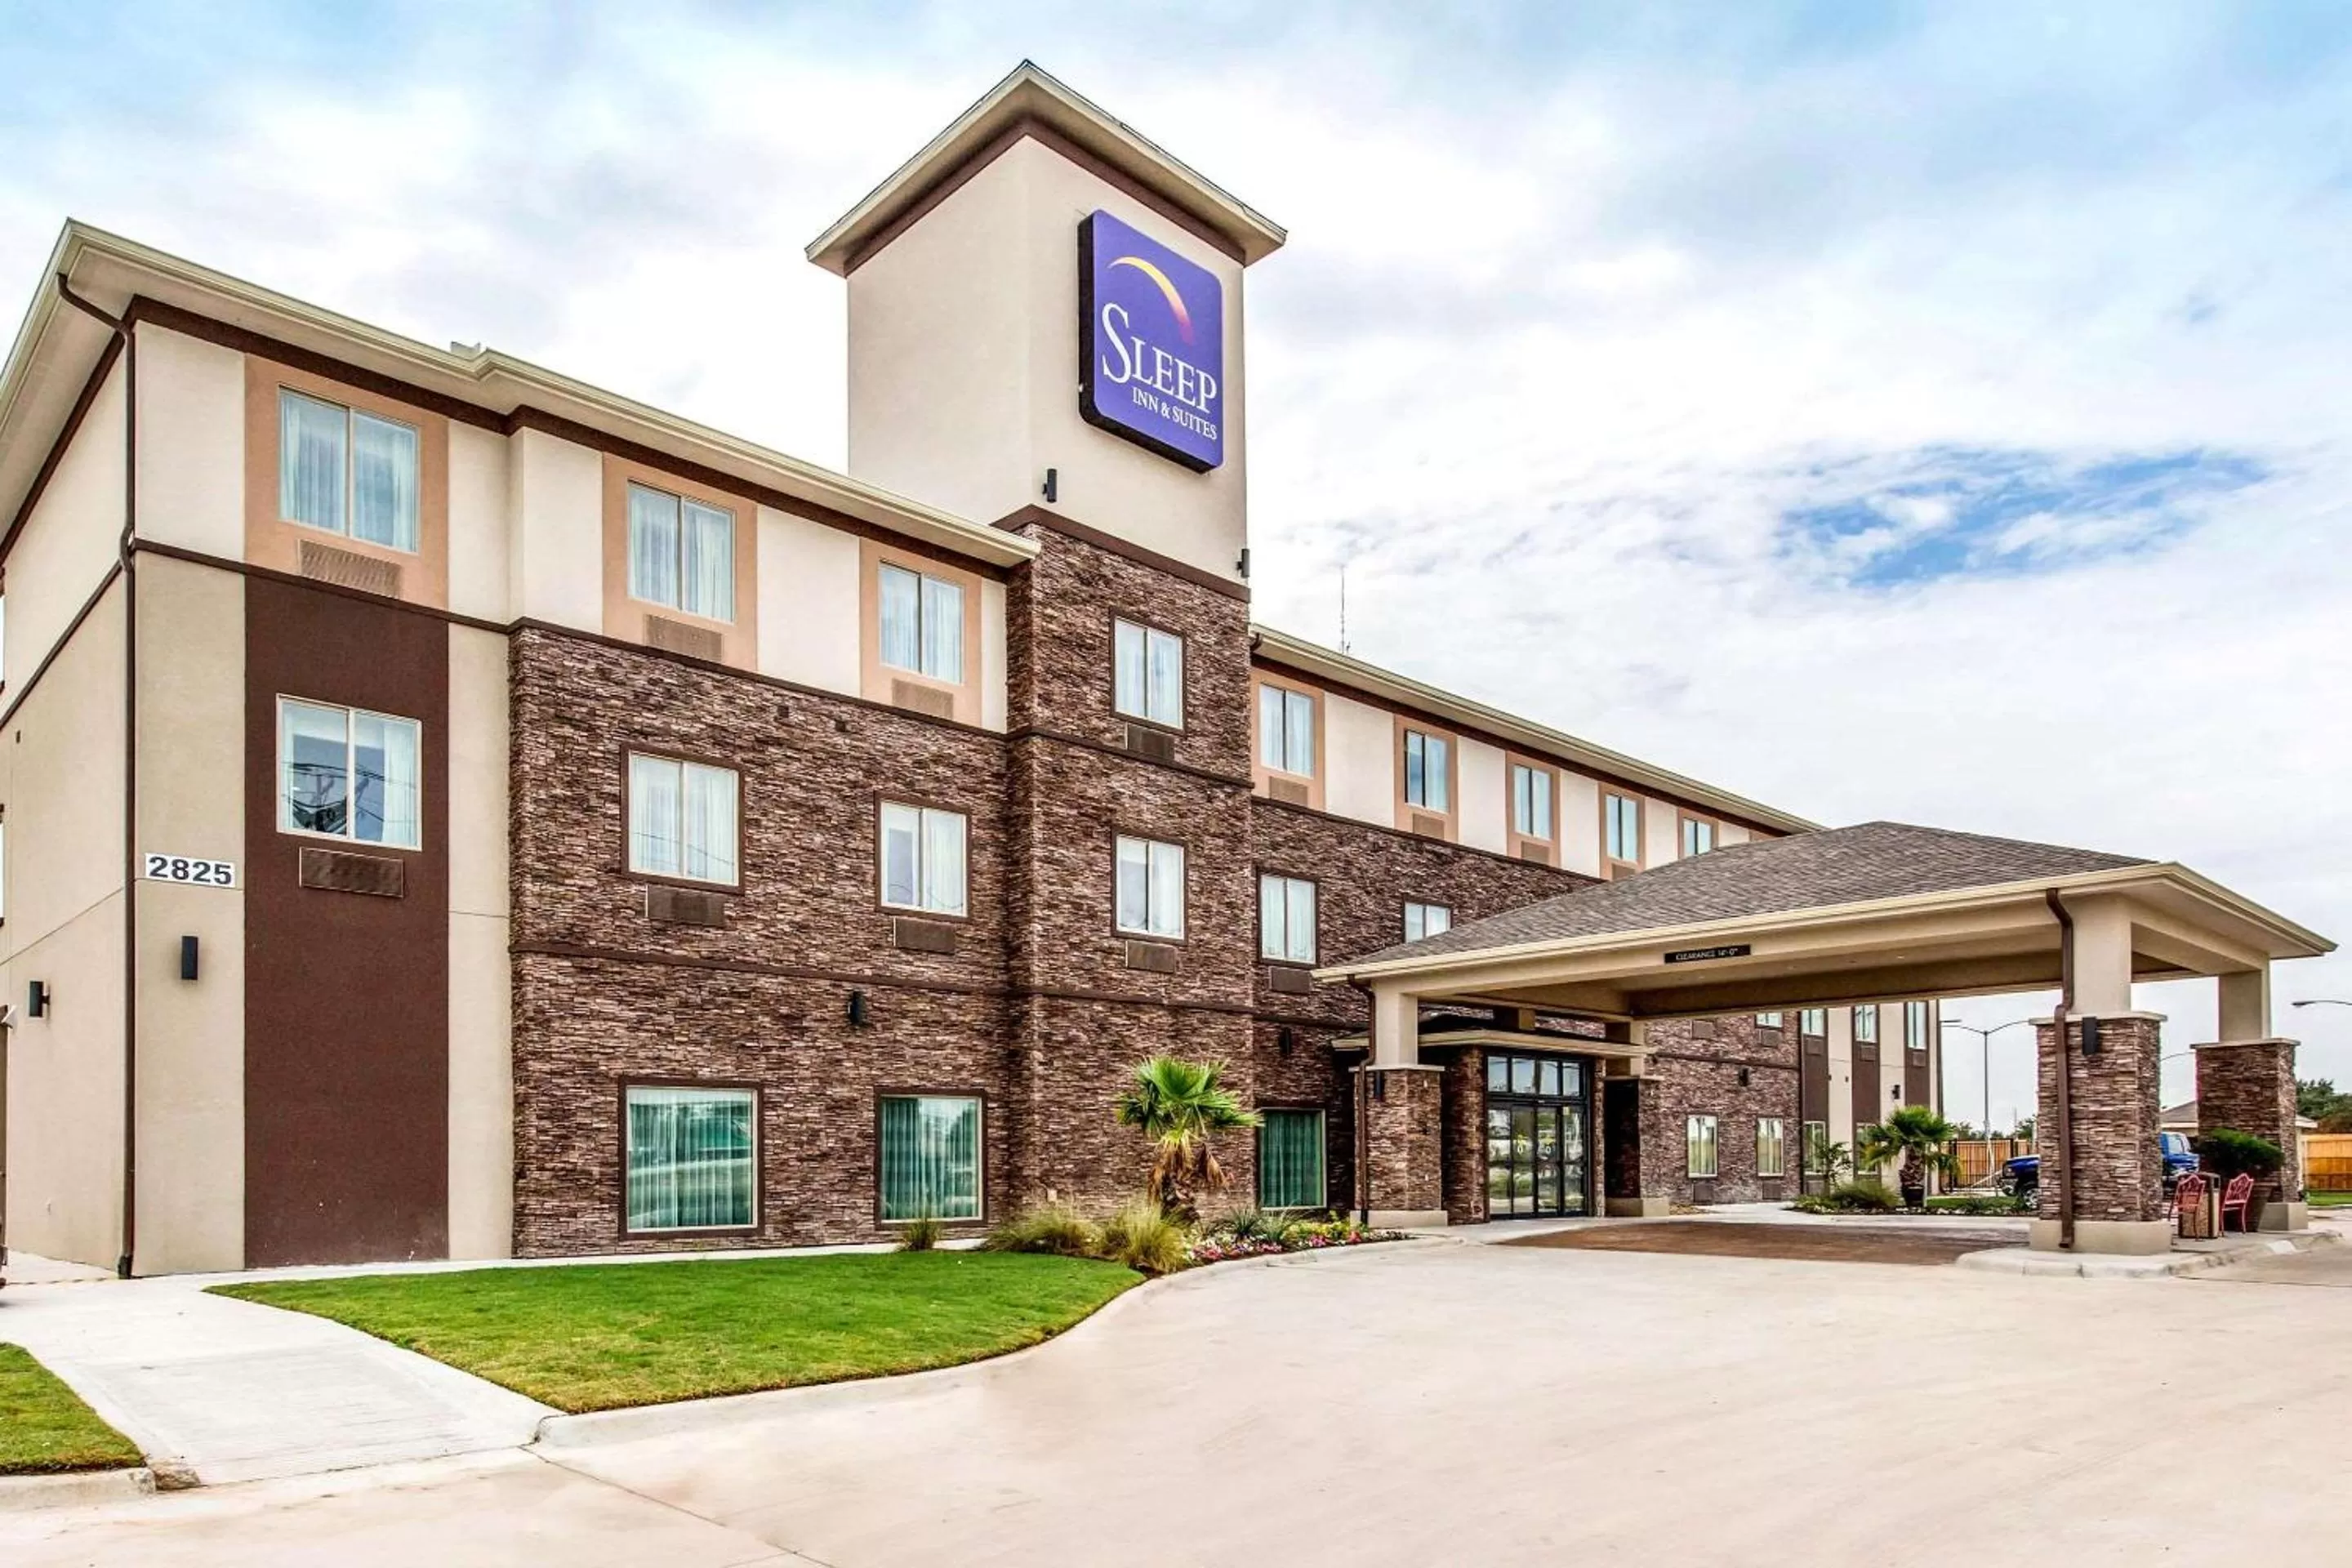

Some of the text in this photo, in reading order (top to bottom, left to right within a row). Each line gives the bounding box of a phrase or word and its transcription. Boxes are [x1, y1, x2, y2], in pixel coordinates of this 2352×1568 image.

[1102, 302, 1217, 413] SLEEP
[1132, 386, 1218, 440] INN & SUITES
[149, 856, 232, 884] 2825
[1675, 950, 1716, 960] CLEARANCE
